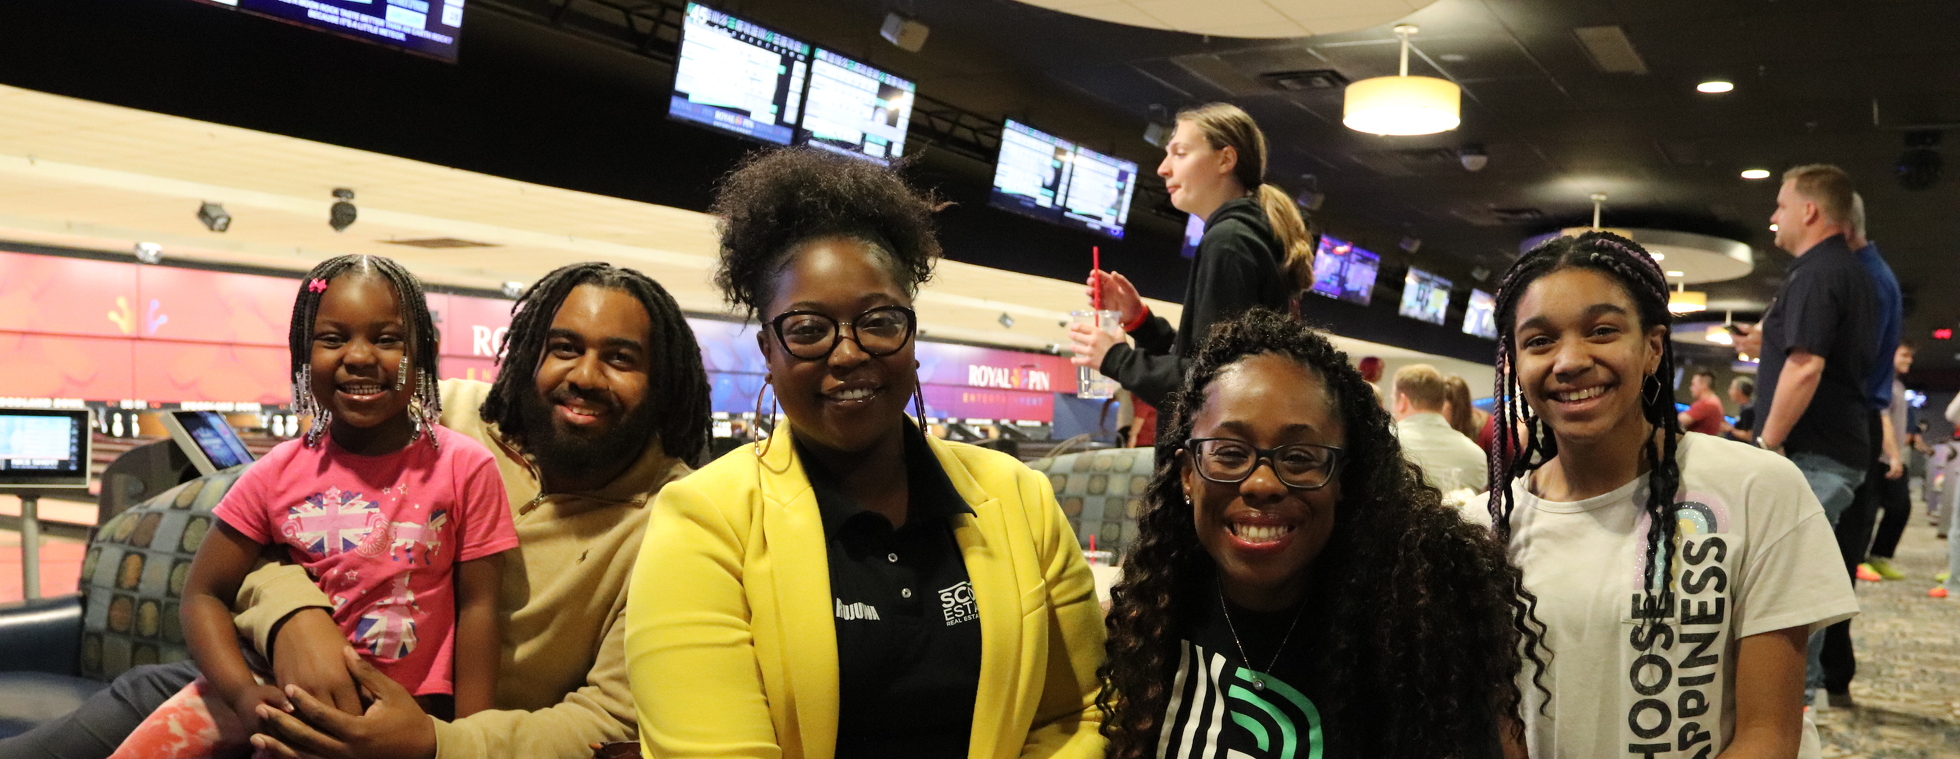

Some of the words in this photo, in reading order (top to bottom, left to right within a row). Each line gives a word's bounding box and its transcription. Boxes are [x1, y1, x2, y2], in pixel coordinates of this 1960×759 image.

[690, 4, 709, 25] 45
[968, 364, 1012, 389] ROYAL
[1028, 370, 1050, 391] PIN
[946, 618, 963, 626] REAL
